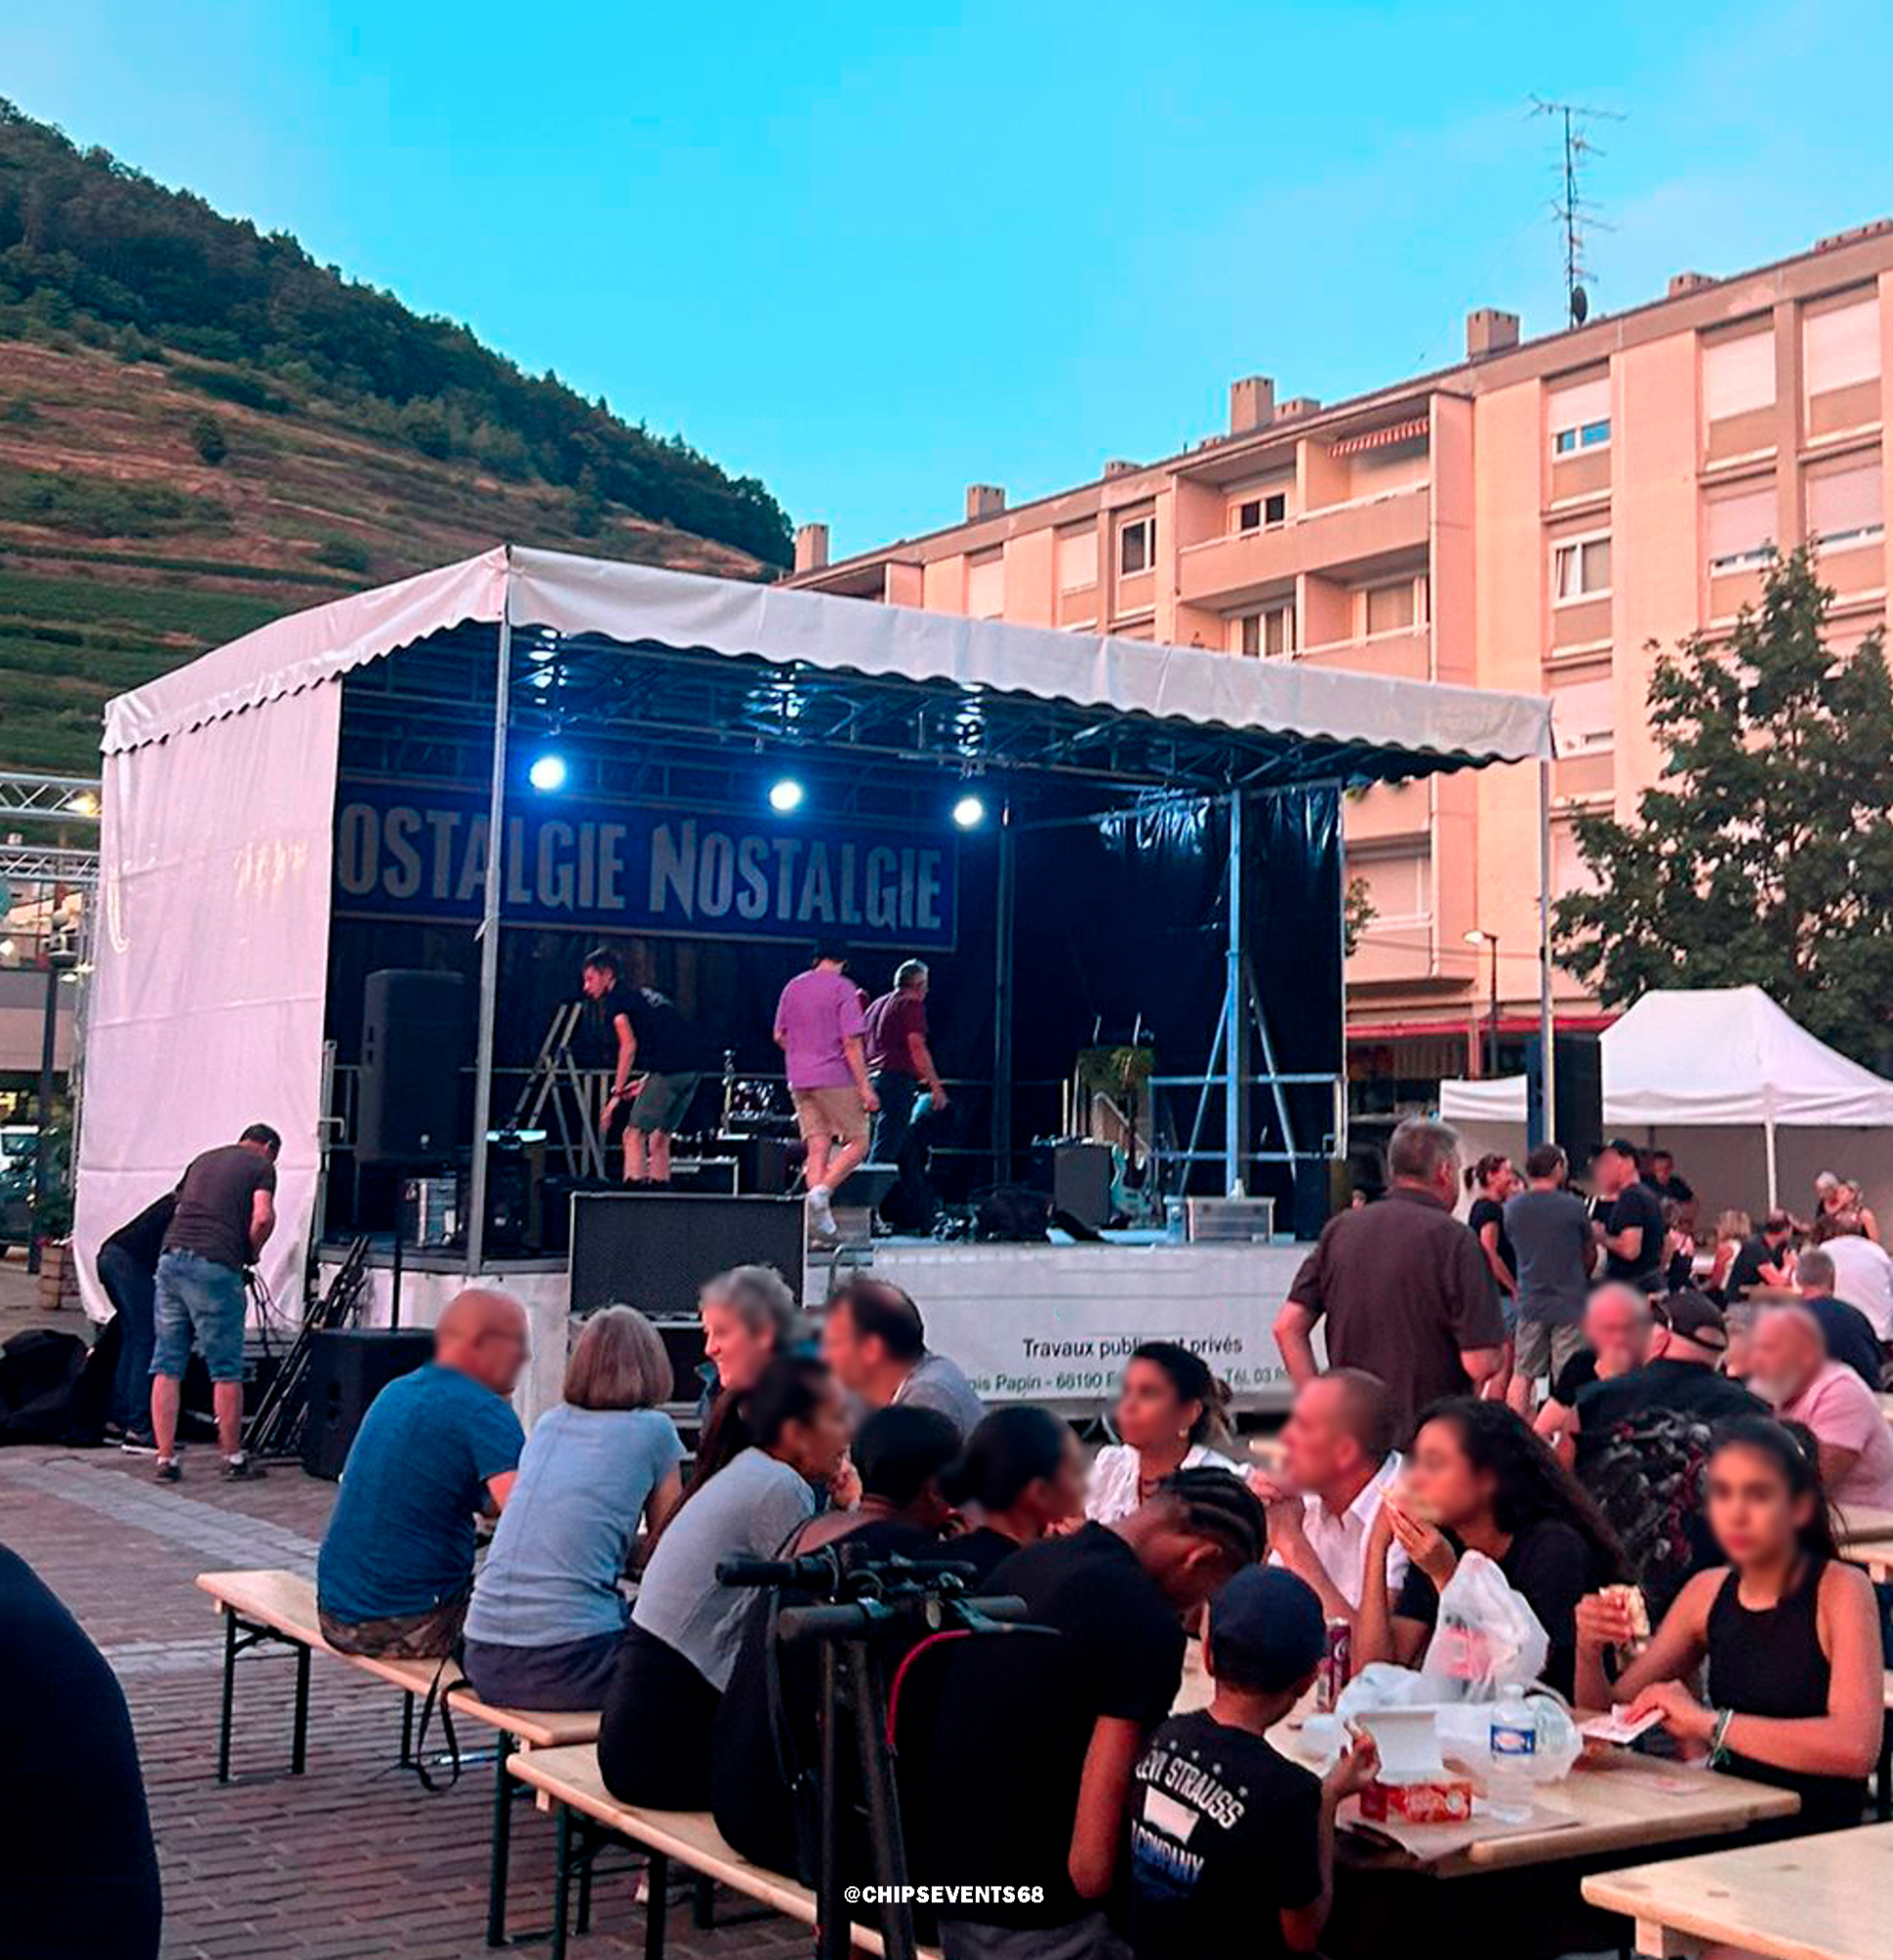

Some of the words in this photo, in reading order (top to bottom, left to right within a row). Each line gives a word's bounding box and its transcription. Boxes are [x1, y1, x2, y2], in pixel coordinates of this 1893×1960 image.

[649, 818, 942, 932] NOSTALGIE
[1022, 1338, 1093, 1357] Travaux
[1099, 1337, 1143, 1360] publi
[1189, 1334, 1243, 1355] privés
[995, 1374, 1042, 1394] Papin
[1164, 1756, 1245, 1830] STRAUSS
